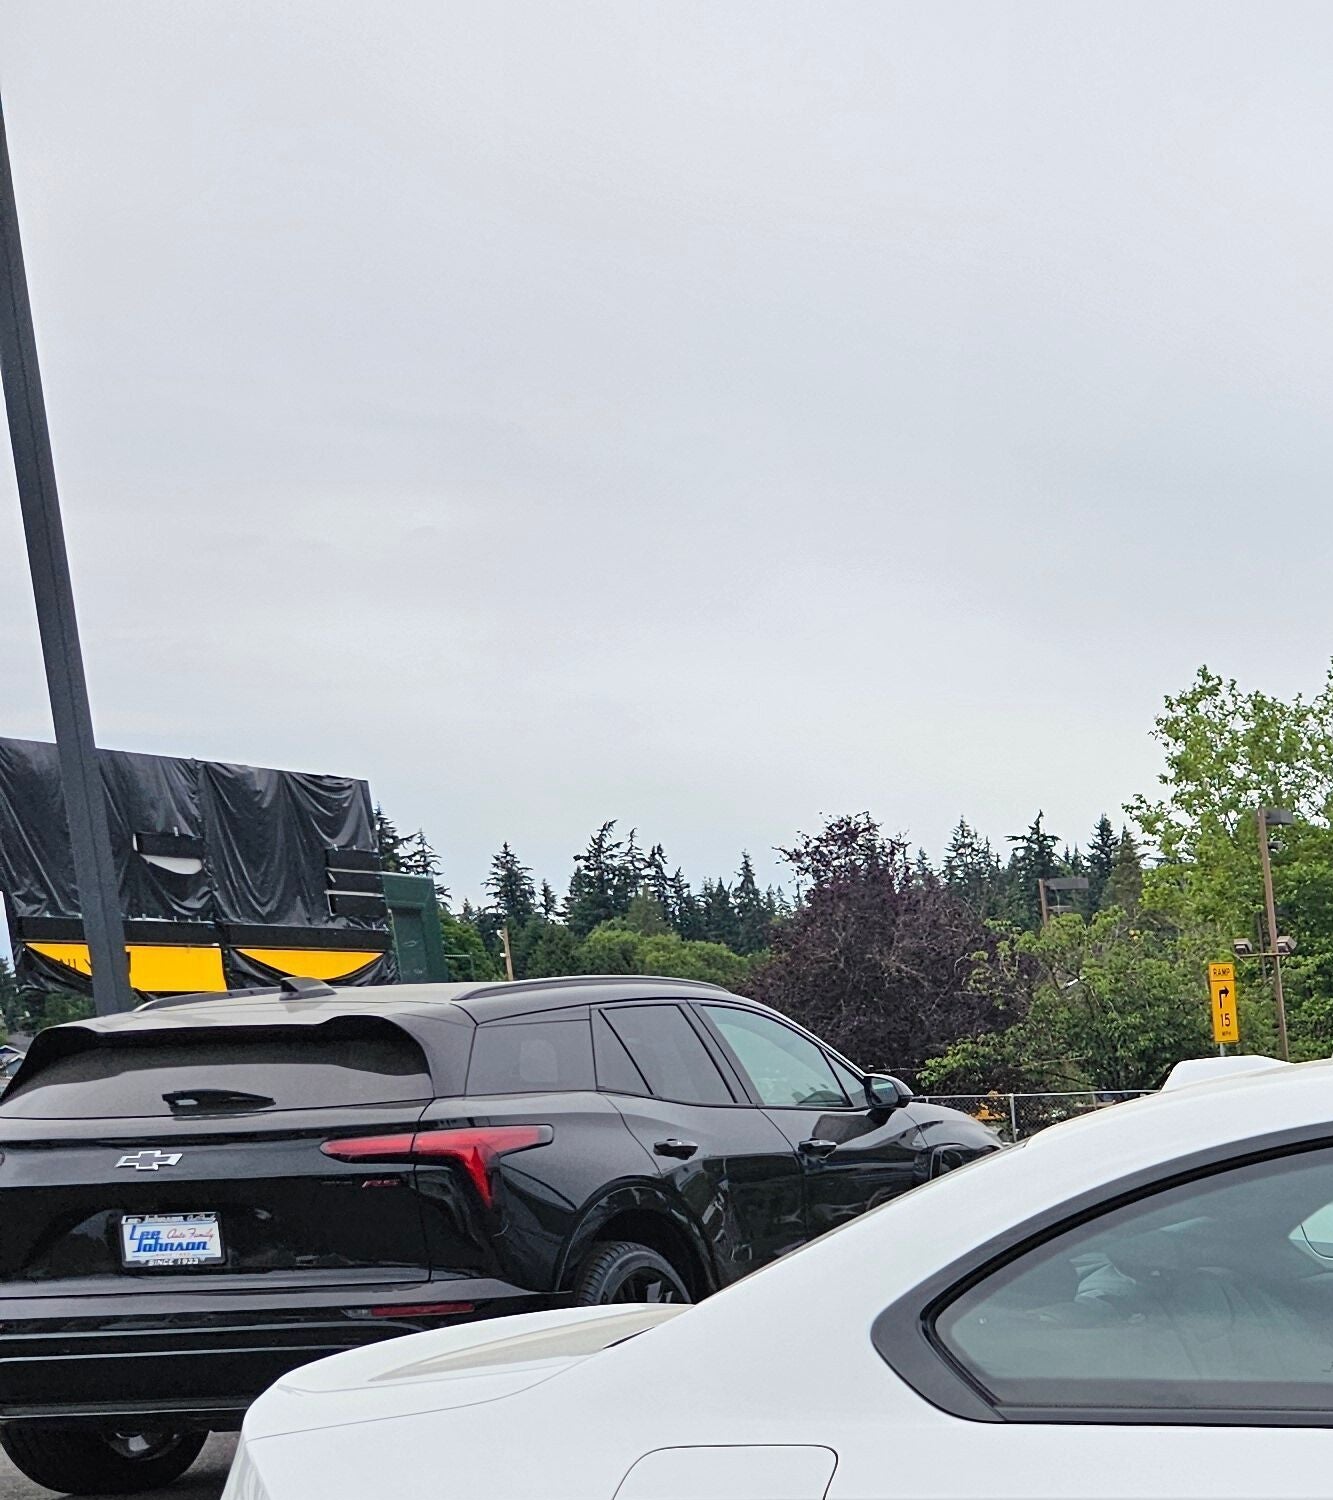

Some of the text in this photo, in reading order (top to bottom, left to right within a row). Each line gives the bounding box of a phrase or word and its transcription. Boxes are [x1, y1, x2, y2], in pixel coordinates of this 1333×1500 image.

[1212, 967, 1231, 976] RAMP
[1220, 1012, 1231, 1027] 15
[129, 1224, 162, 1240] Lee
[132, 1236, 210, 1253] Johnson
